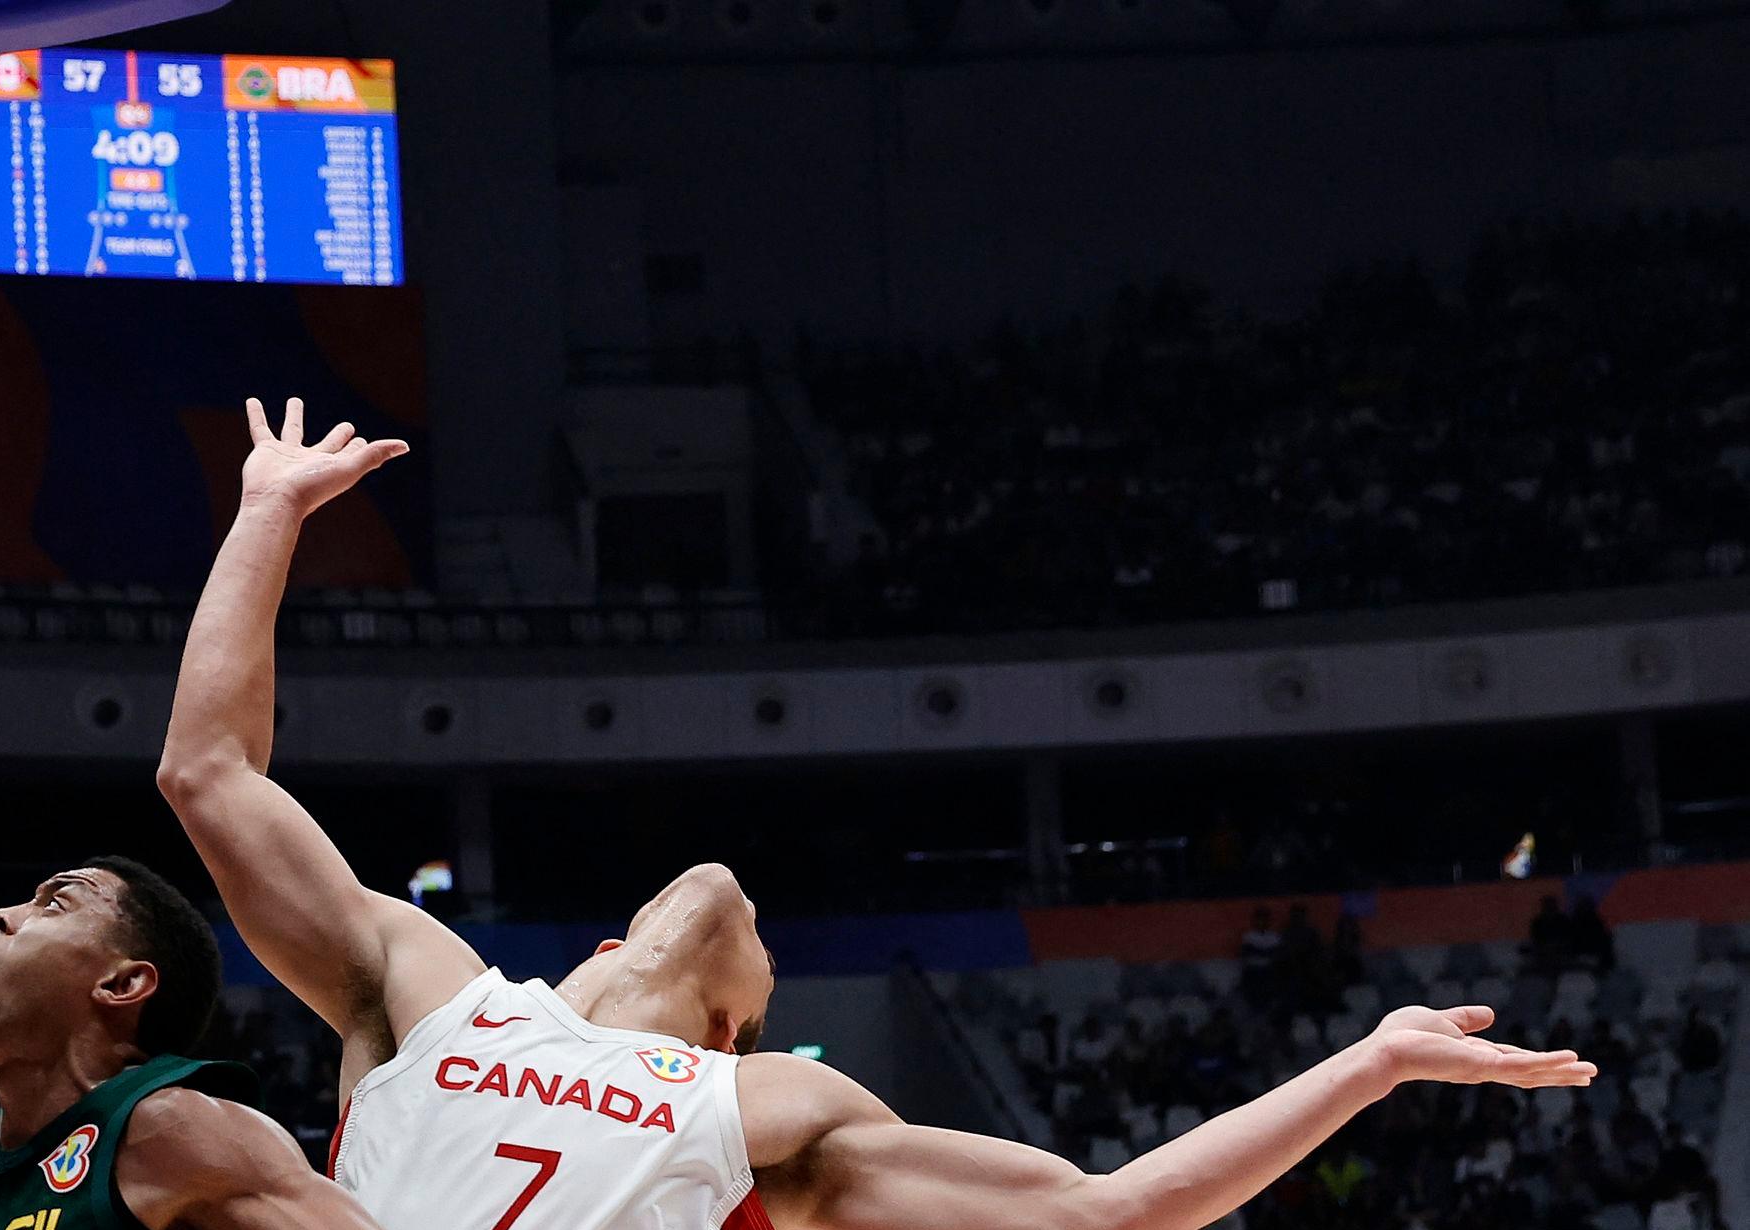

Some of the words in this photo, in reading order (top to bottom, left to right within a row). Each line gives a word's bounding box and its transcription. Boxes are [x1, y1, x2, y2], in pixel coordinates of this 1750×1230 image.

[63, 59, 106, 93] 57
[157, 63, 202, 97] 55
[277, 66, 356, 102] BRA
[91, 129, 180, 167] 4:09
[435, 1056, 676, 1133] CANADA
